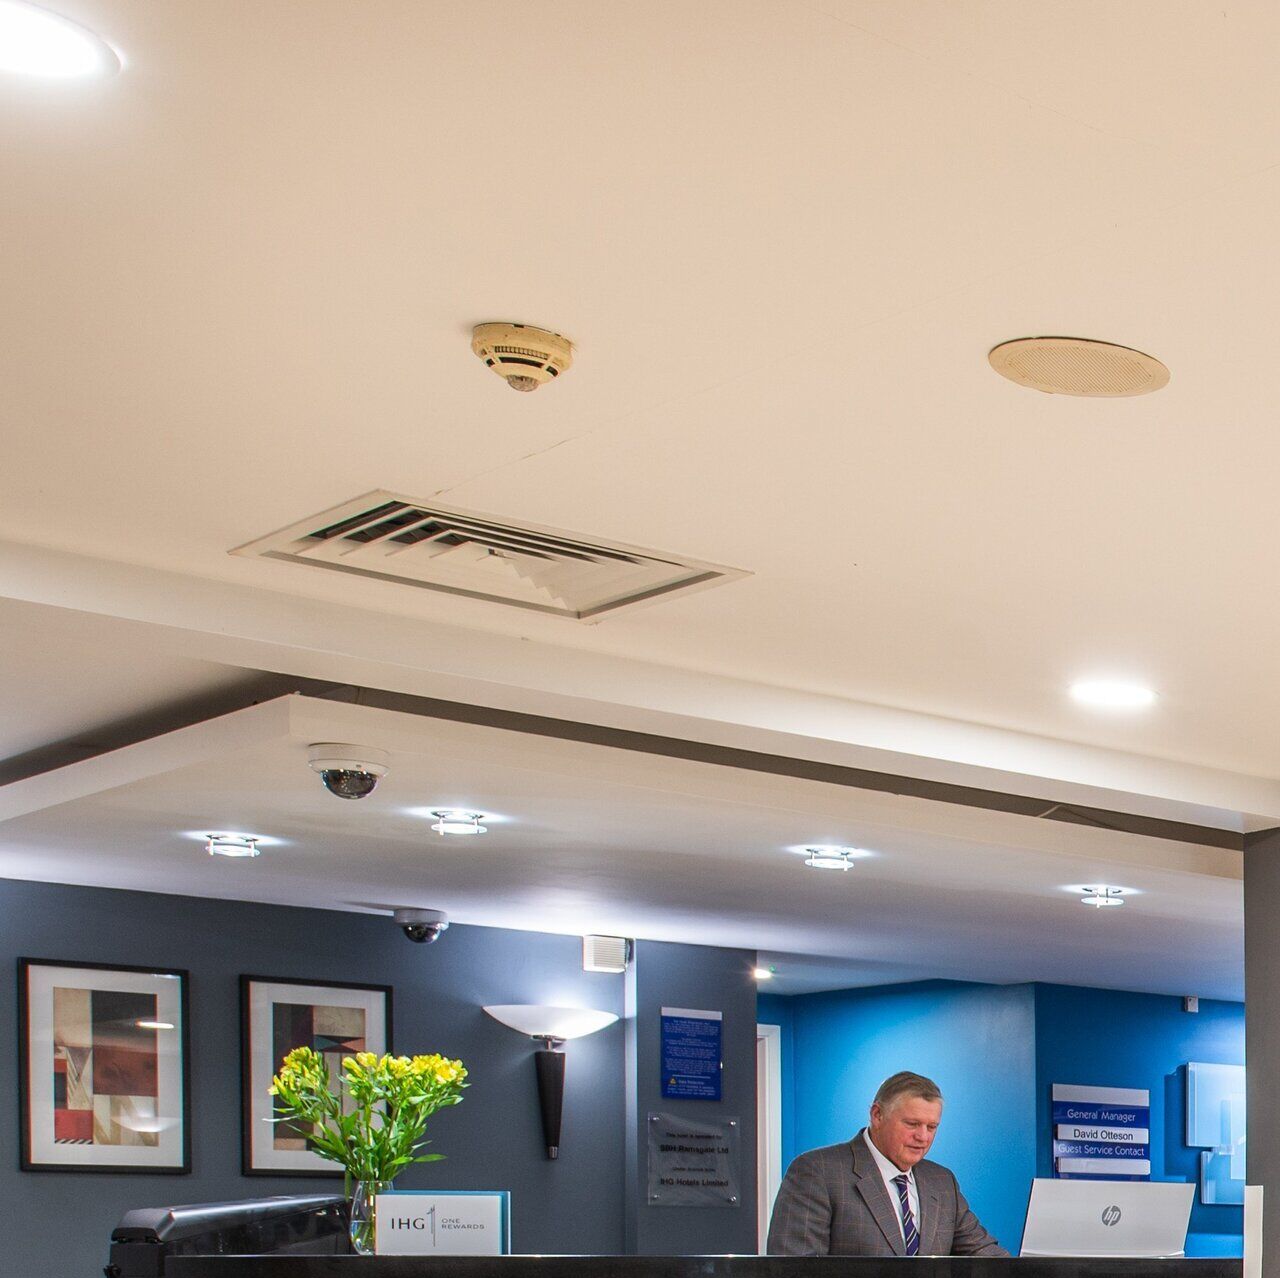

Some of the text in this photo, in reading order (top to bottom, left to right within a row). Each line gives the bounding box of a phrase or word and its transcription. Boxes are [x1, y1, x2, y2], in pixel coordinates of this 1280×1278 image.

[1067, 1109, 1136, 1123] General Manager
[1073, 1128, 1134, 1141] David Otteson
[1058, 1143, 1145, 1157] Guest Service Contact
[676, 1179, 700, 1187] Hotels
[702, 1179, 729, 1187] Limited
[1102, 1205, 1121, 1226] hp
[391, 1218, 425, 1229] IHG
